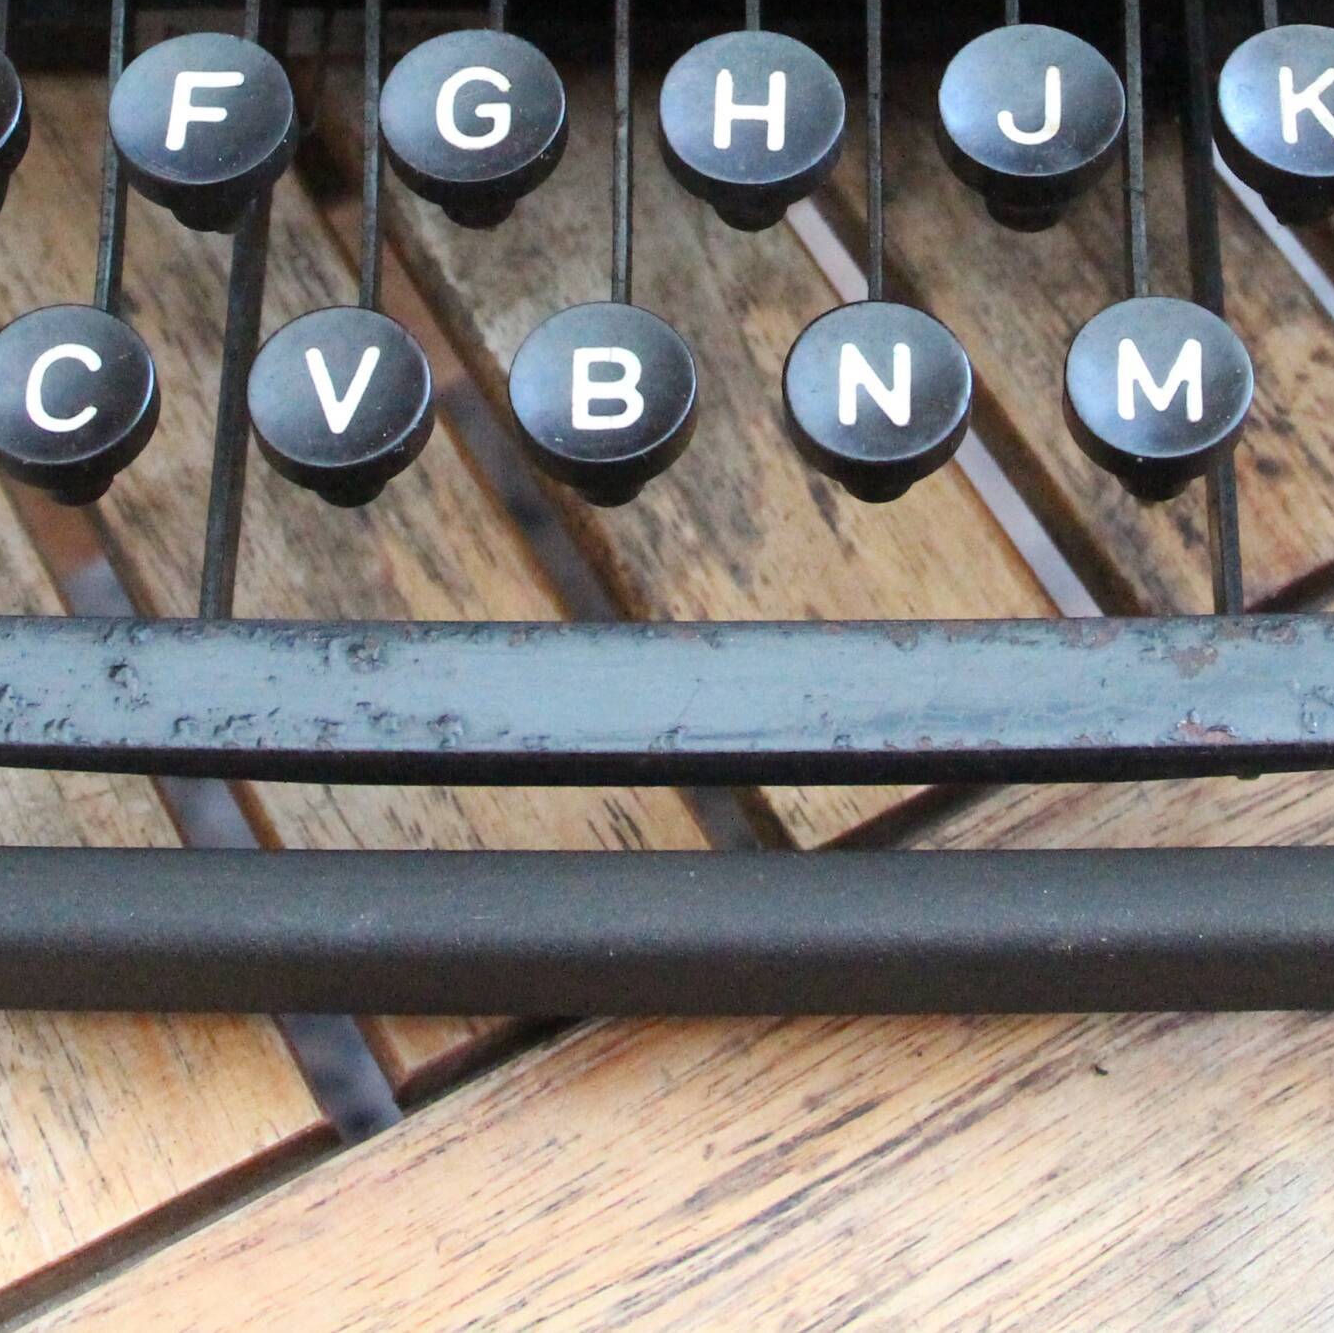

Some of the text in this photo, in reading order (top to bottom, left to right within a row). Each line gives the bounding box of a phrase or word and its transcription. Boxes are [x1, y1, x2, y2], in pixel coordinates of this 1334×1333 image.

[165, 70, 245, 153] F
[435, 65, 512, 152] G
[713, 67, 788, 153] H
[997, 64, 1063, 147] J
[25, 342, 104, 434] C
[304, 344, 382, 436] V
[571, 345, 646, 432] B
[837, 342, 912, 428] N
[1117, 337, 1205, 424] M
